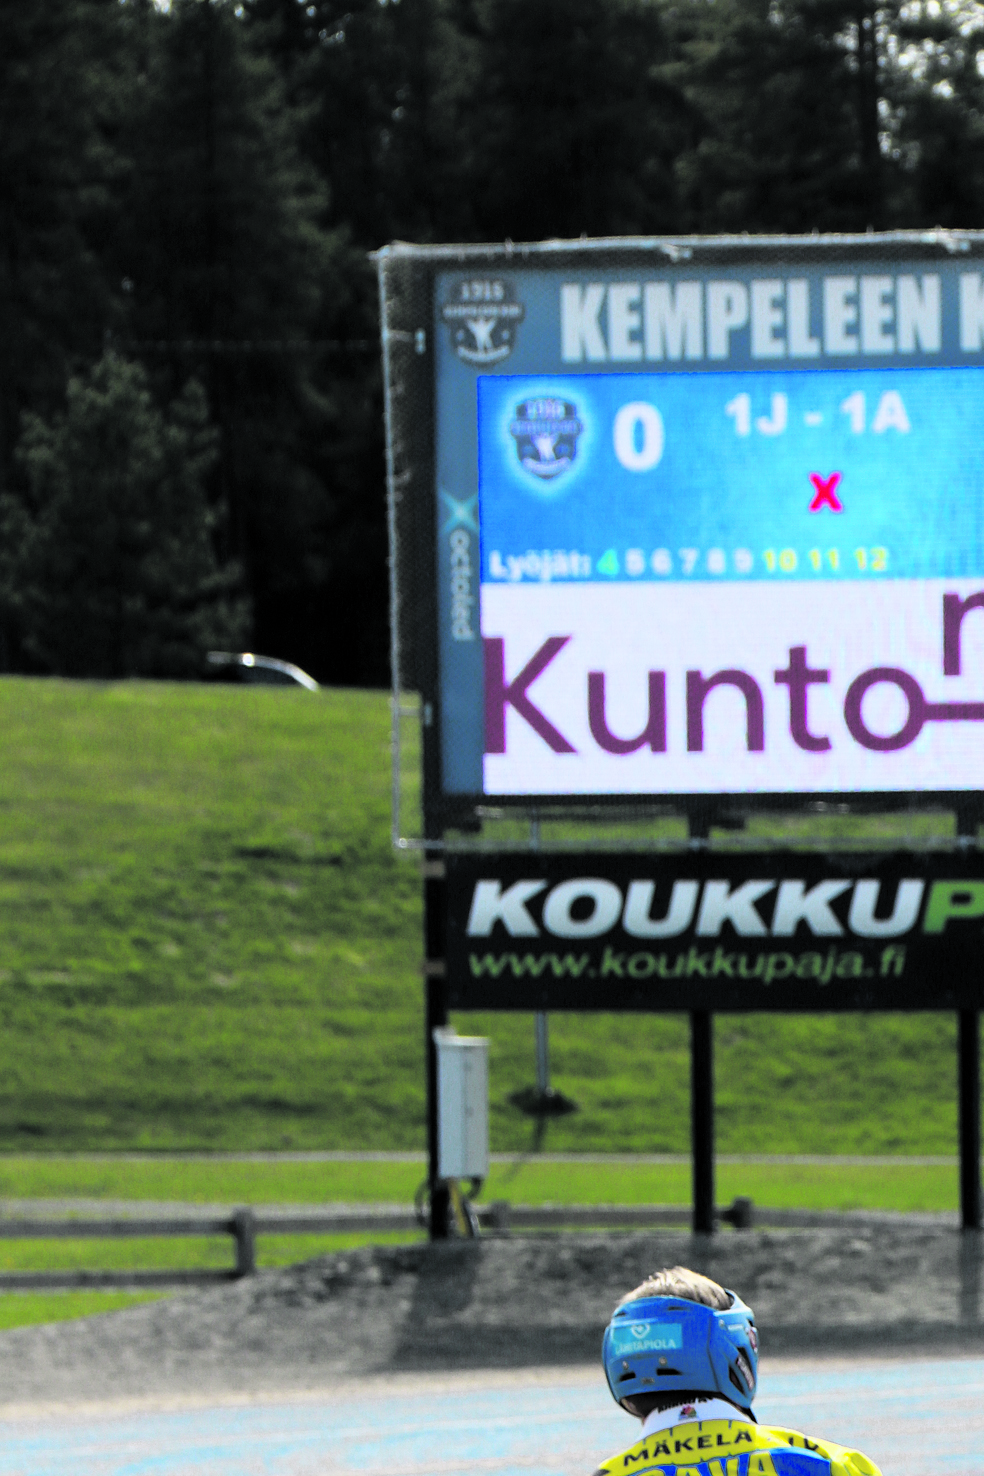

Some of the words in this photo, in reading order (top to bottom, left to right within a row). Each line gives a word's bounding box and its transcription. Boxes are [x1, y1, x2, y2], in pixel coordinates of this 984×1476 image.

[560, 272, 941, 363] KEMPELEEN
[724, 391, 789, 437] 1J
[840, 389, 911, 435] 1A
[612, 400, 666, 472] 0
[677, 546, 699, 576] 7
[763, 545, 798, 573] 10
[808, 545, 840, 573] 11
[854, 545, 890, 573] 12
[468, 945, 906, 985] www.koukkupaja.fi
[623, 1429, 753, 1468] MÄKELÄ
